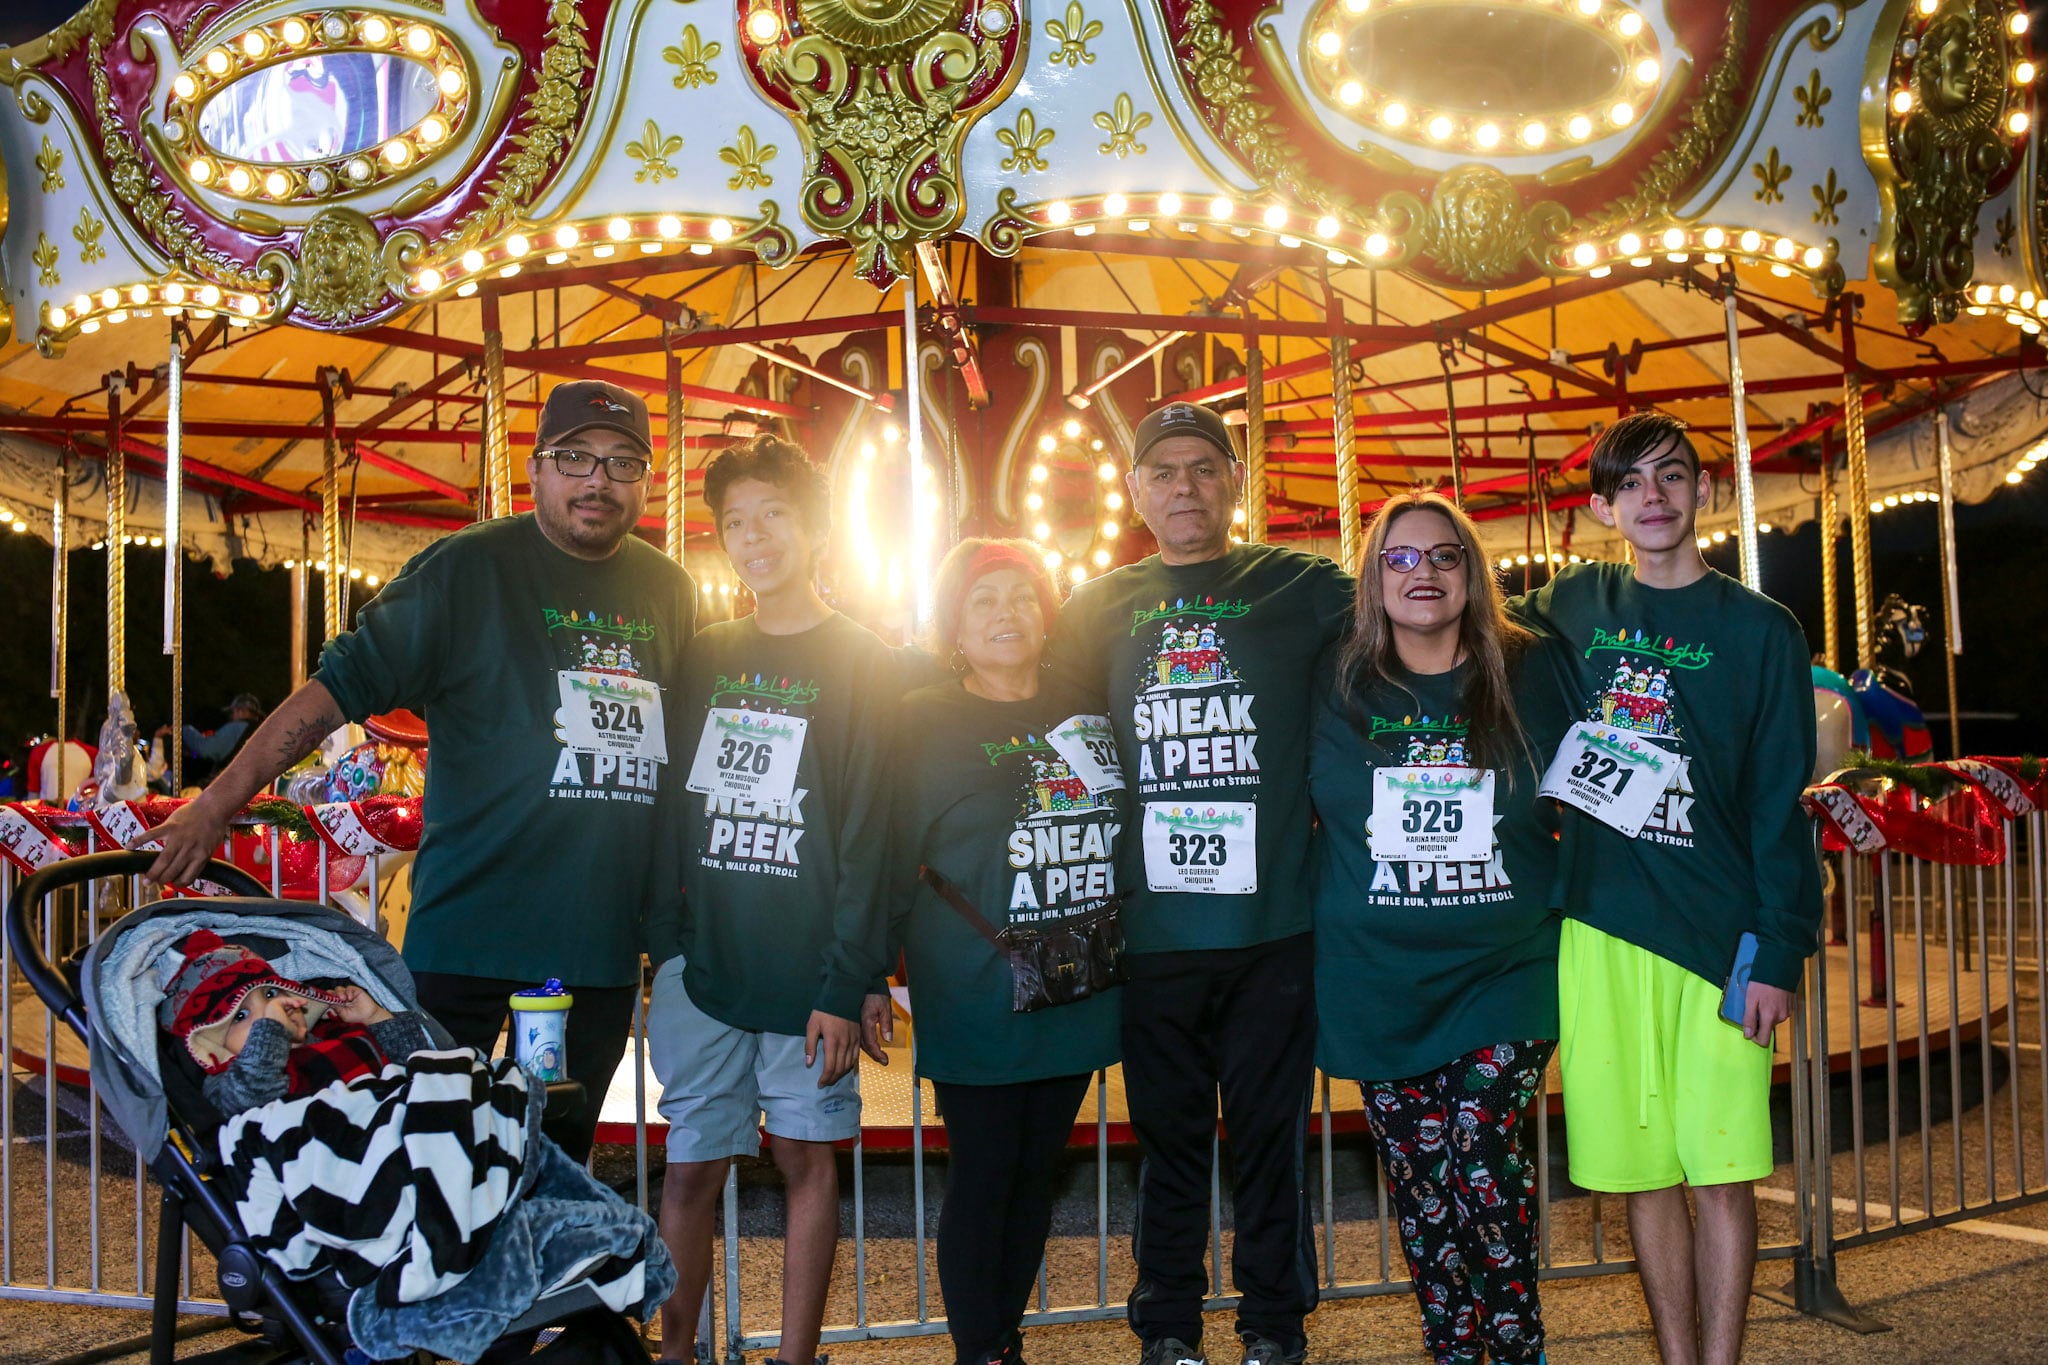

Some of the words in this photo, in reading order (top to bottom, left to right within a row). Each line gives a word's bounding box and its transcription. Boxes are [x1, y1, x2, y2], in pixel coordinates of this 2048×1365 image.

[1651, 635, 1714, 669] Lights
[590, 700, 644, 734] 324
[1133, 694, 1258, 741] SNEAK
[550, 747, 584, 787] A
[592, 754, 659, 792] PEEK
[717, 738, 773, 775] 326
[1139, 743, 1158, 782] A
[1163, 735, 1260, 779] PEEK
[1160, 782, 1181, 791] RUN,
[1183, 779, 1210, 789] WALK
[1212, 778, 1227, 787] OR
[1227, 775, 1261, 787] STROLL
[1571, 751, 1635, 797] 321
[549, 789, 556, 798] 3
[559, 789, 582, 798] MILE
[585, 790, 608, 801] RUN,
[611, 791, 632, 801] WALK
[1566, 778, 1584, 789] NOAH
[1583, 785, 1615, 805] CAMPBELL
[1570, 788, 1602, 808] CHIQUILIN
[1027, 819, 1052, 828] ANNUAL
[1402, 800, 1463, 833] 325
[1645, 793, 1695, 835] EK
[708, 818, 806, 865] PEEK
[1008, 823, 1121, 869] SNEAK
[1169, 834, 1227, 866] 323
[1430, 836, 1458, 844] MUSQUIZ
[1640, 831, 1654, 841] OR
[1655, 831, 1695, 848] STROLL
[701, 857, 723, 871] RUN,
[726, 861, 747, 873] WALK
[749, 864, 761, 874] OR
[763, 863, 798, 878] STROLL
[1184, 877, 1214, 885] CHIQUILIN
[1189, 868, 1220, 876] GUERRERO
[1369, 861, 1401, 893] A
[1407, 850, 1513, 895] PEEK
[1008, 872, 1040, 911] A
[1046, 862, 1116, 906] PEEK
[1368, 895, 1374, 905] 3
[1377, 896, 1400, 906] MILE
[1404, 897, 1428, 908] RUN,
[1431, 896, 1460, 907] WALK
[1462, 895, 1477, 905] OR
[1478, 890, 1514, 903] STROLL
[1009, 914, 1014, 923] 3
[1017, 912, 1040, 922] MILE
[1064, 906, 1085, 917] WALK
[1087, 903, 1096, 911] OR
